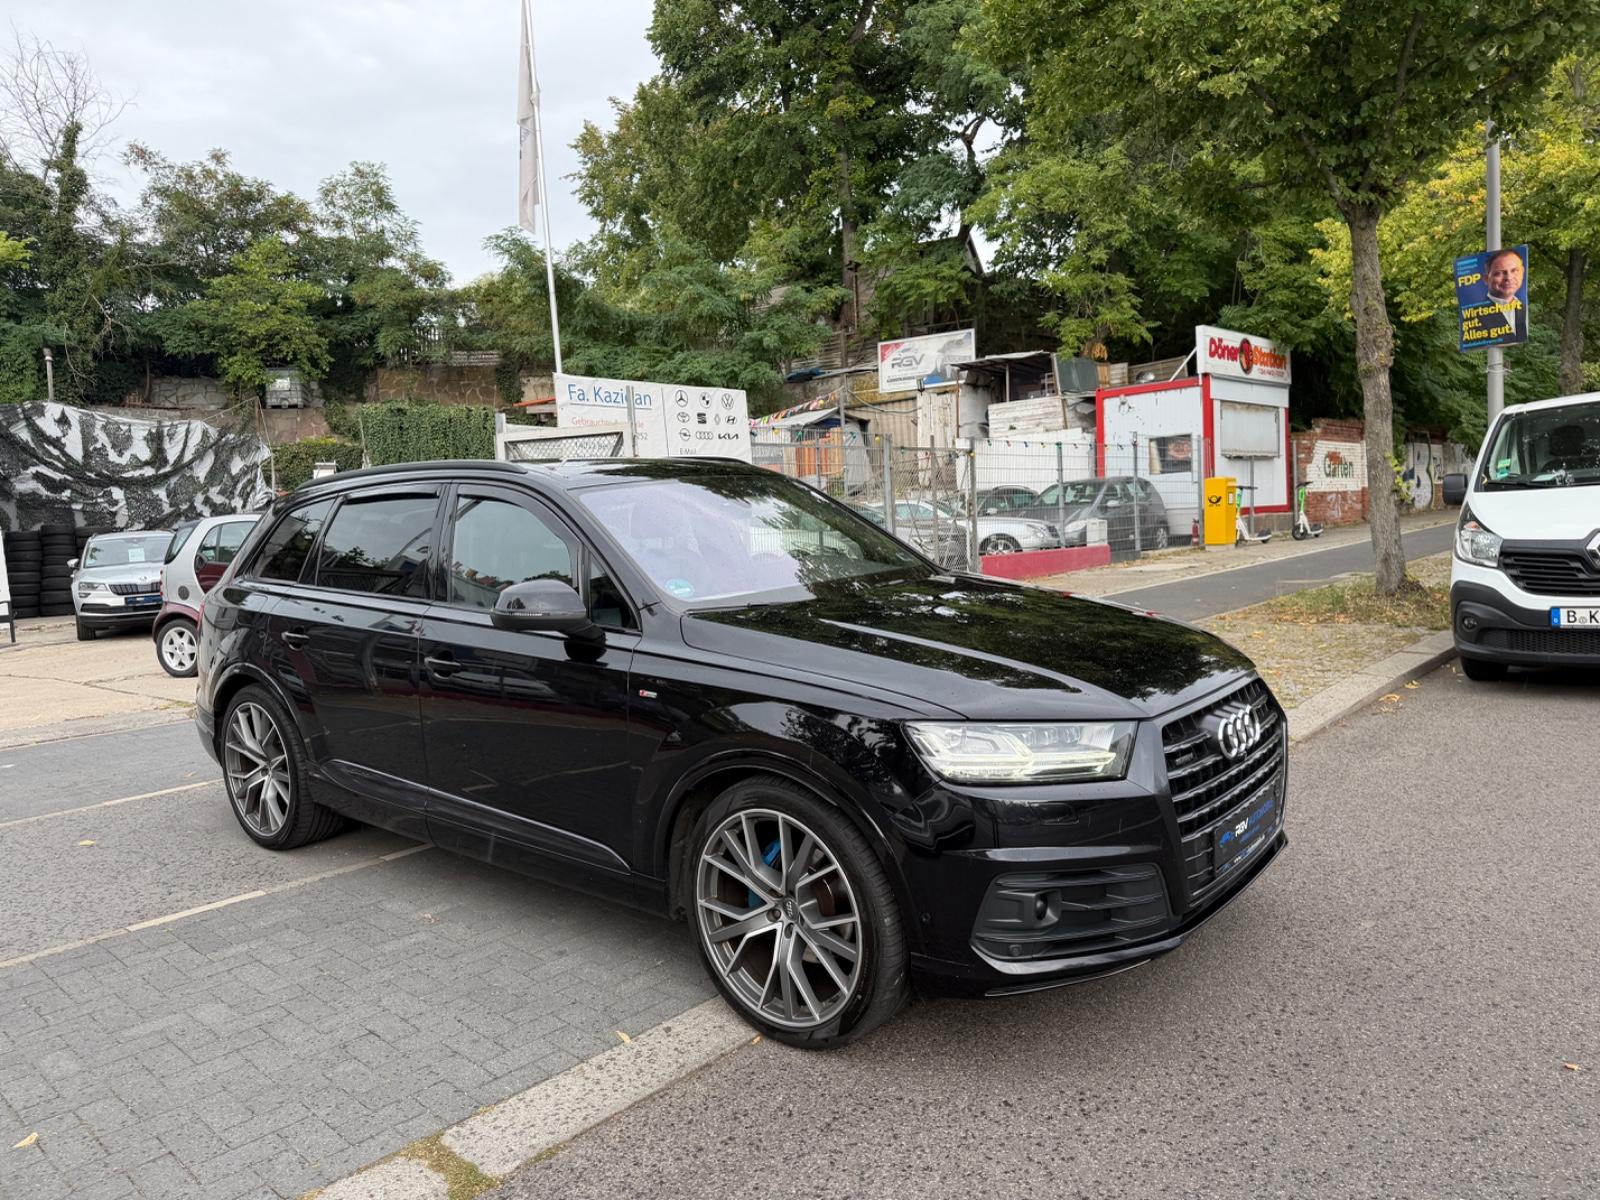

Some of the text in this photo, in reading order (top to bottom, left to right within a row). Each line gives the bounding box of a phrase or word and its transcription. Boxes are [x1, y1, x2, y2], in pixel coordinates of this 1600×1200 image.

[1458, 273, 1481, 287] FDP
[1462, 301, 1522, 319] Wirtschaft
[1463, 328, 1488, 341] Alles
[1209, 337, 1239, 362] Döner
[568, 384, 652, 407] Fa. Kazian
[1566, 610, 1577, 624] B
